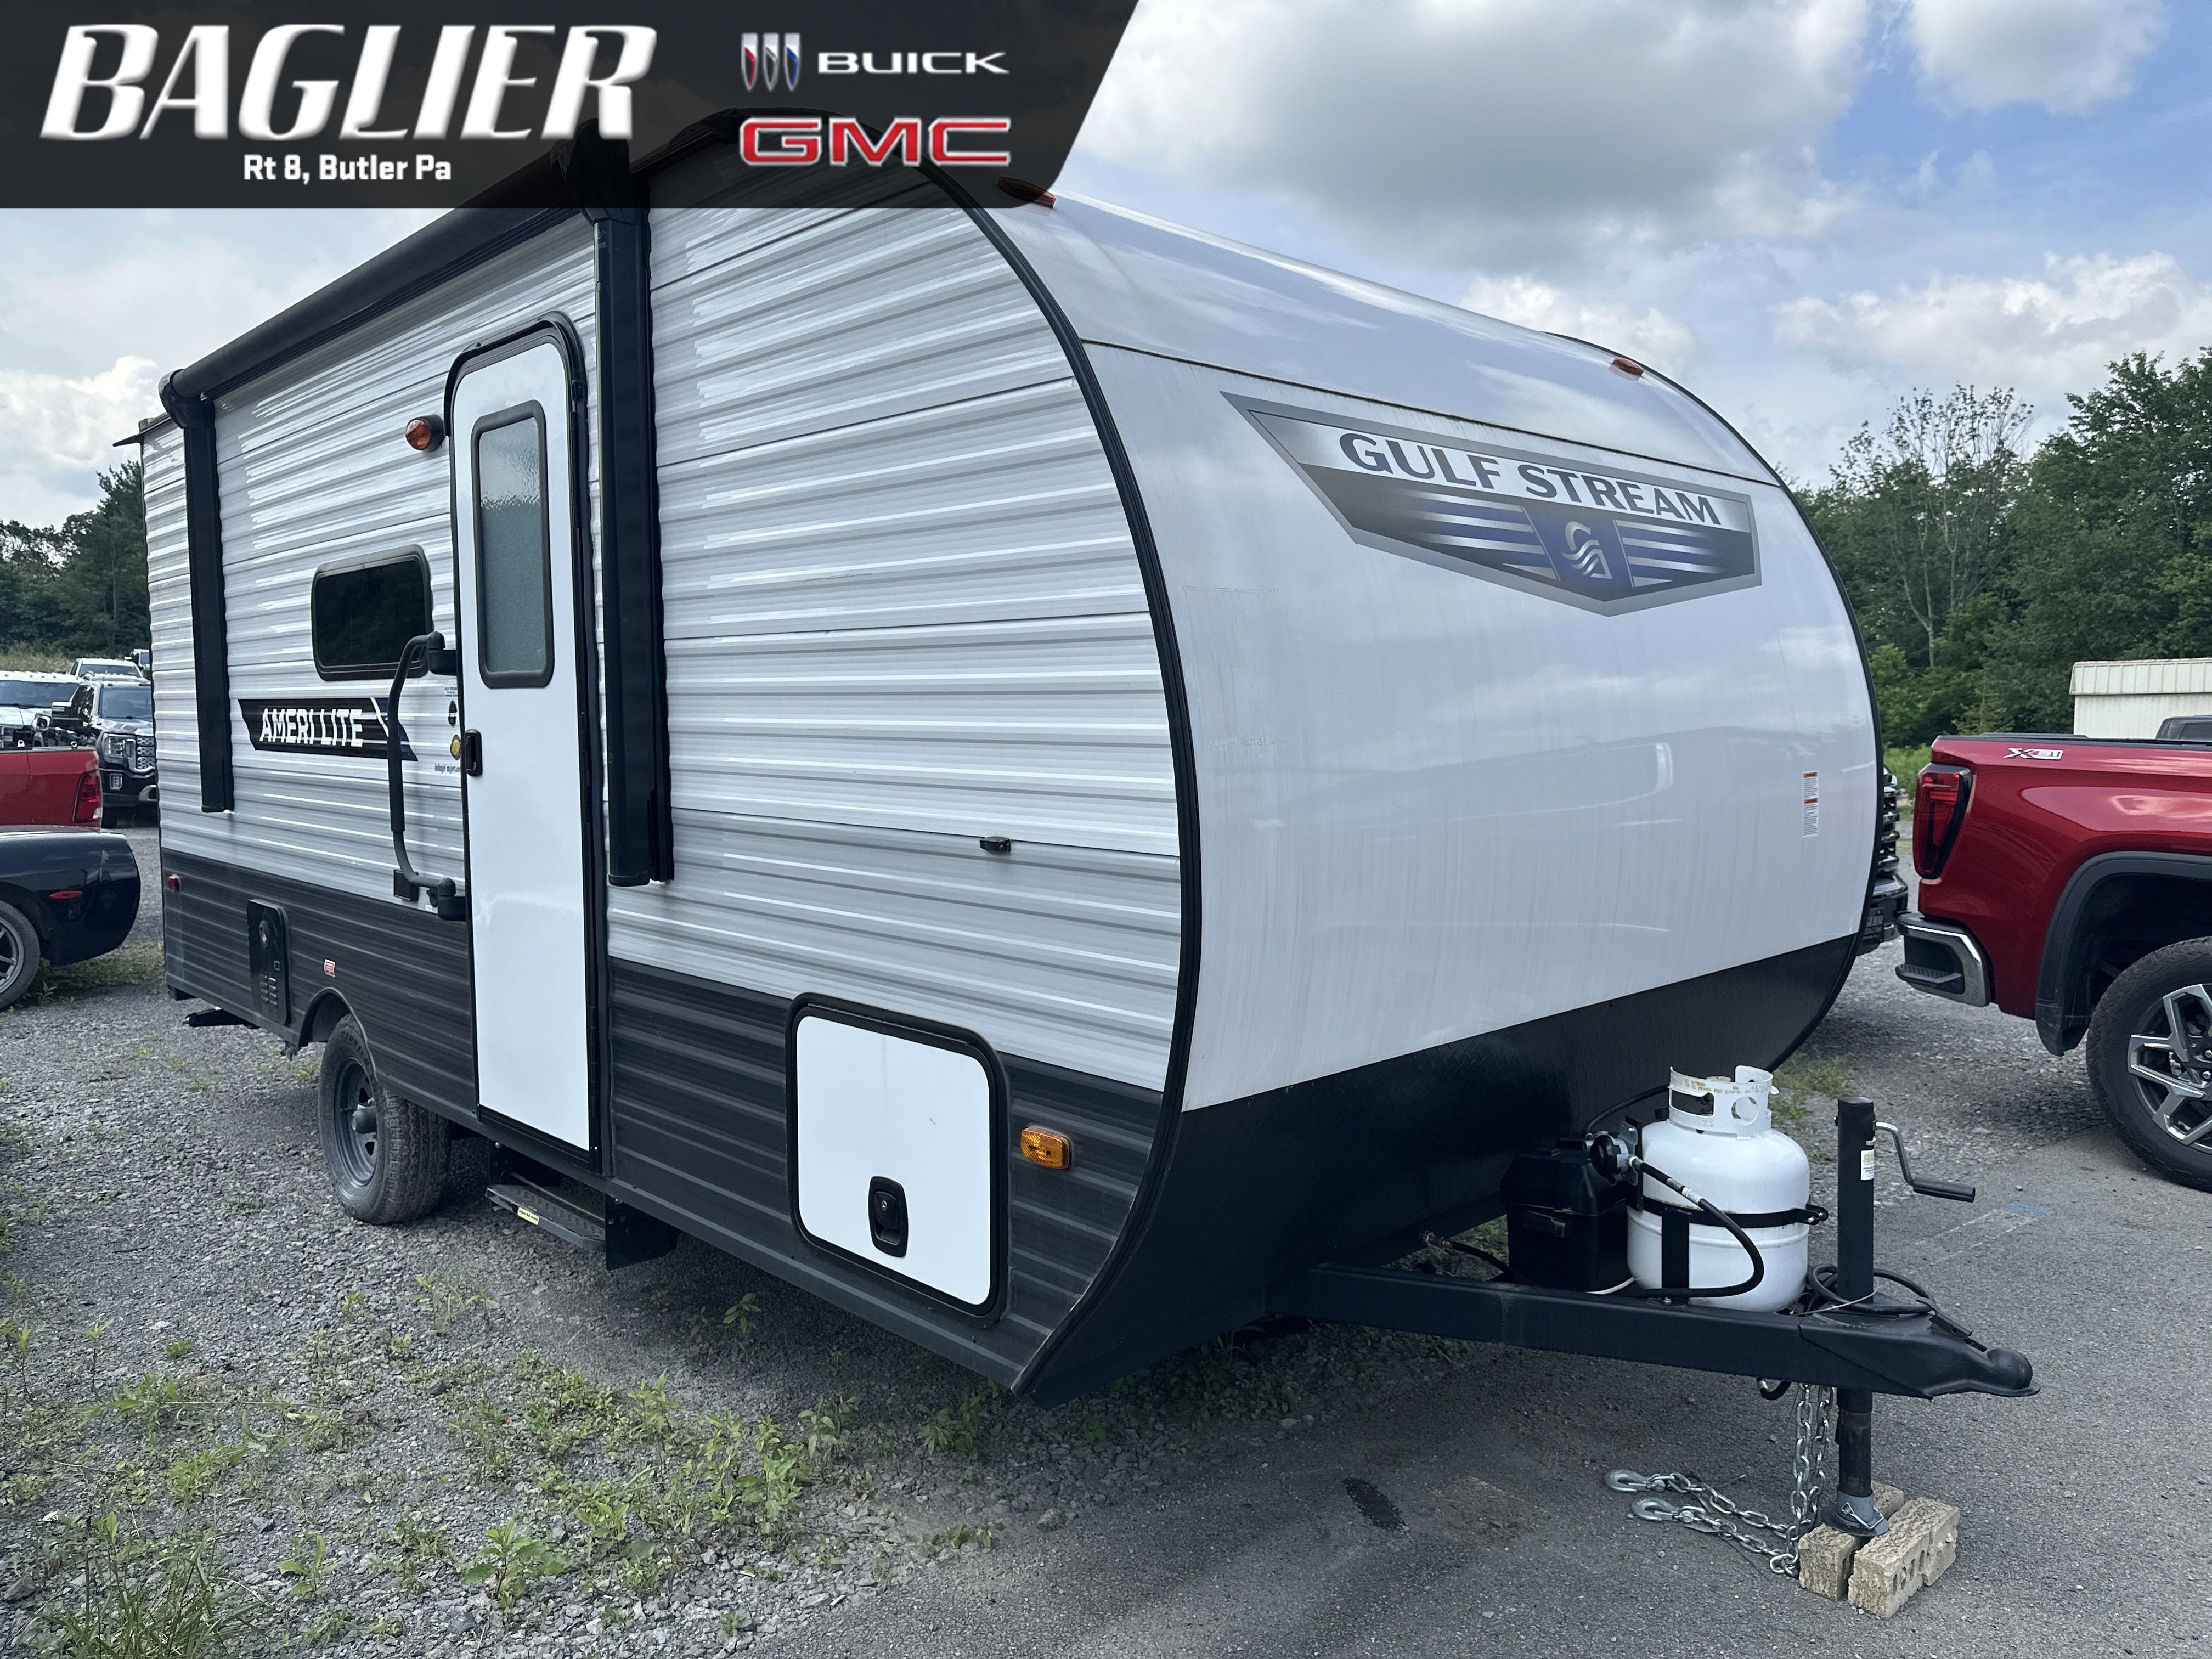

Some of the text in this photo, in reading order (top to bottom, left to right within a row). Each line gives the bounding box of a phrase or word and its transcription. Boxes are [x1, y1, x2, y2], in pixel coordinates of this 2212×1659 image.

[1339, 433, 1721, 526] GULF STREAM
[259, 708, 363, 747] AMERI LITE
